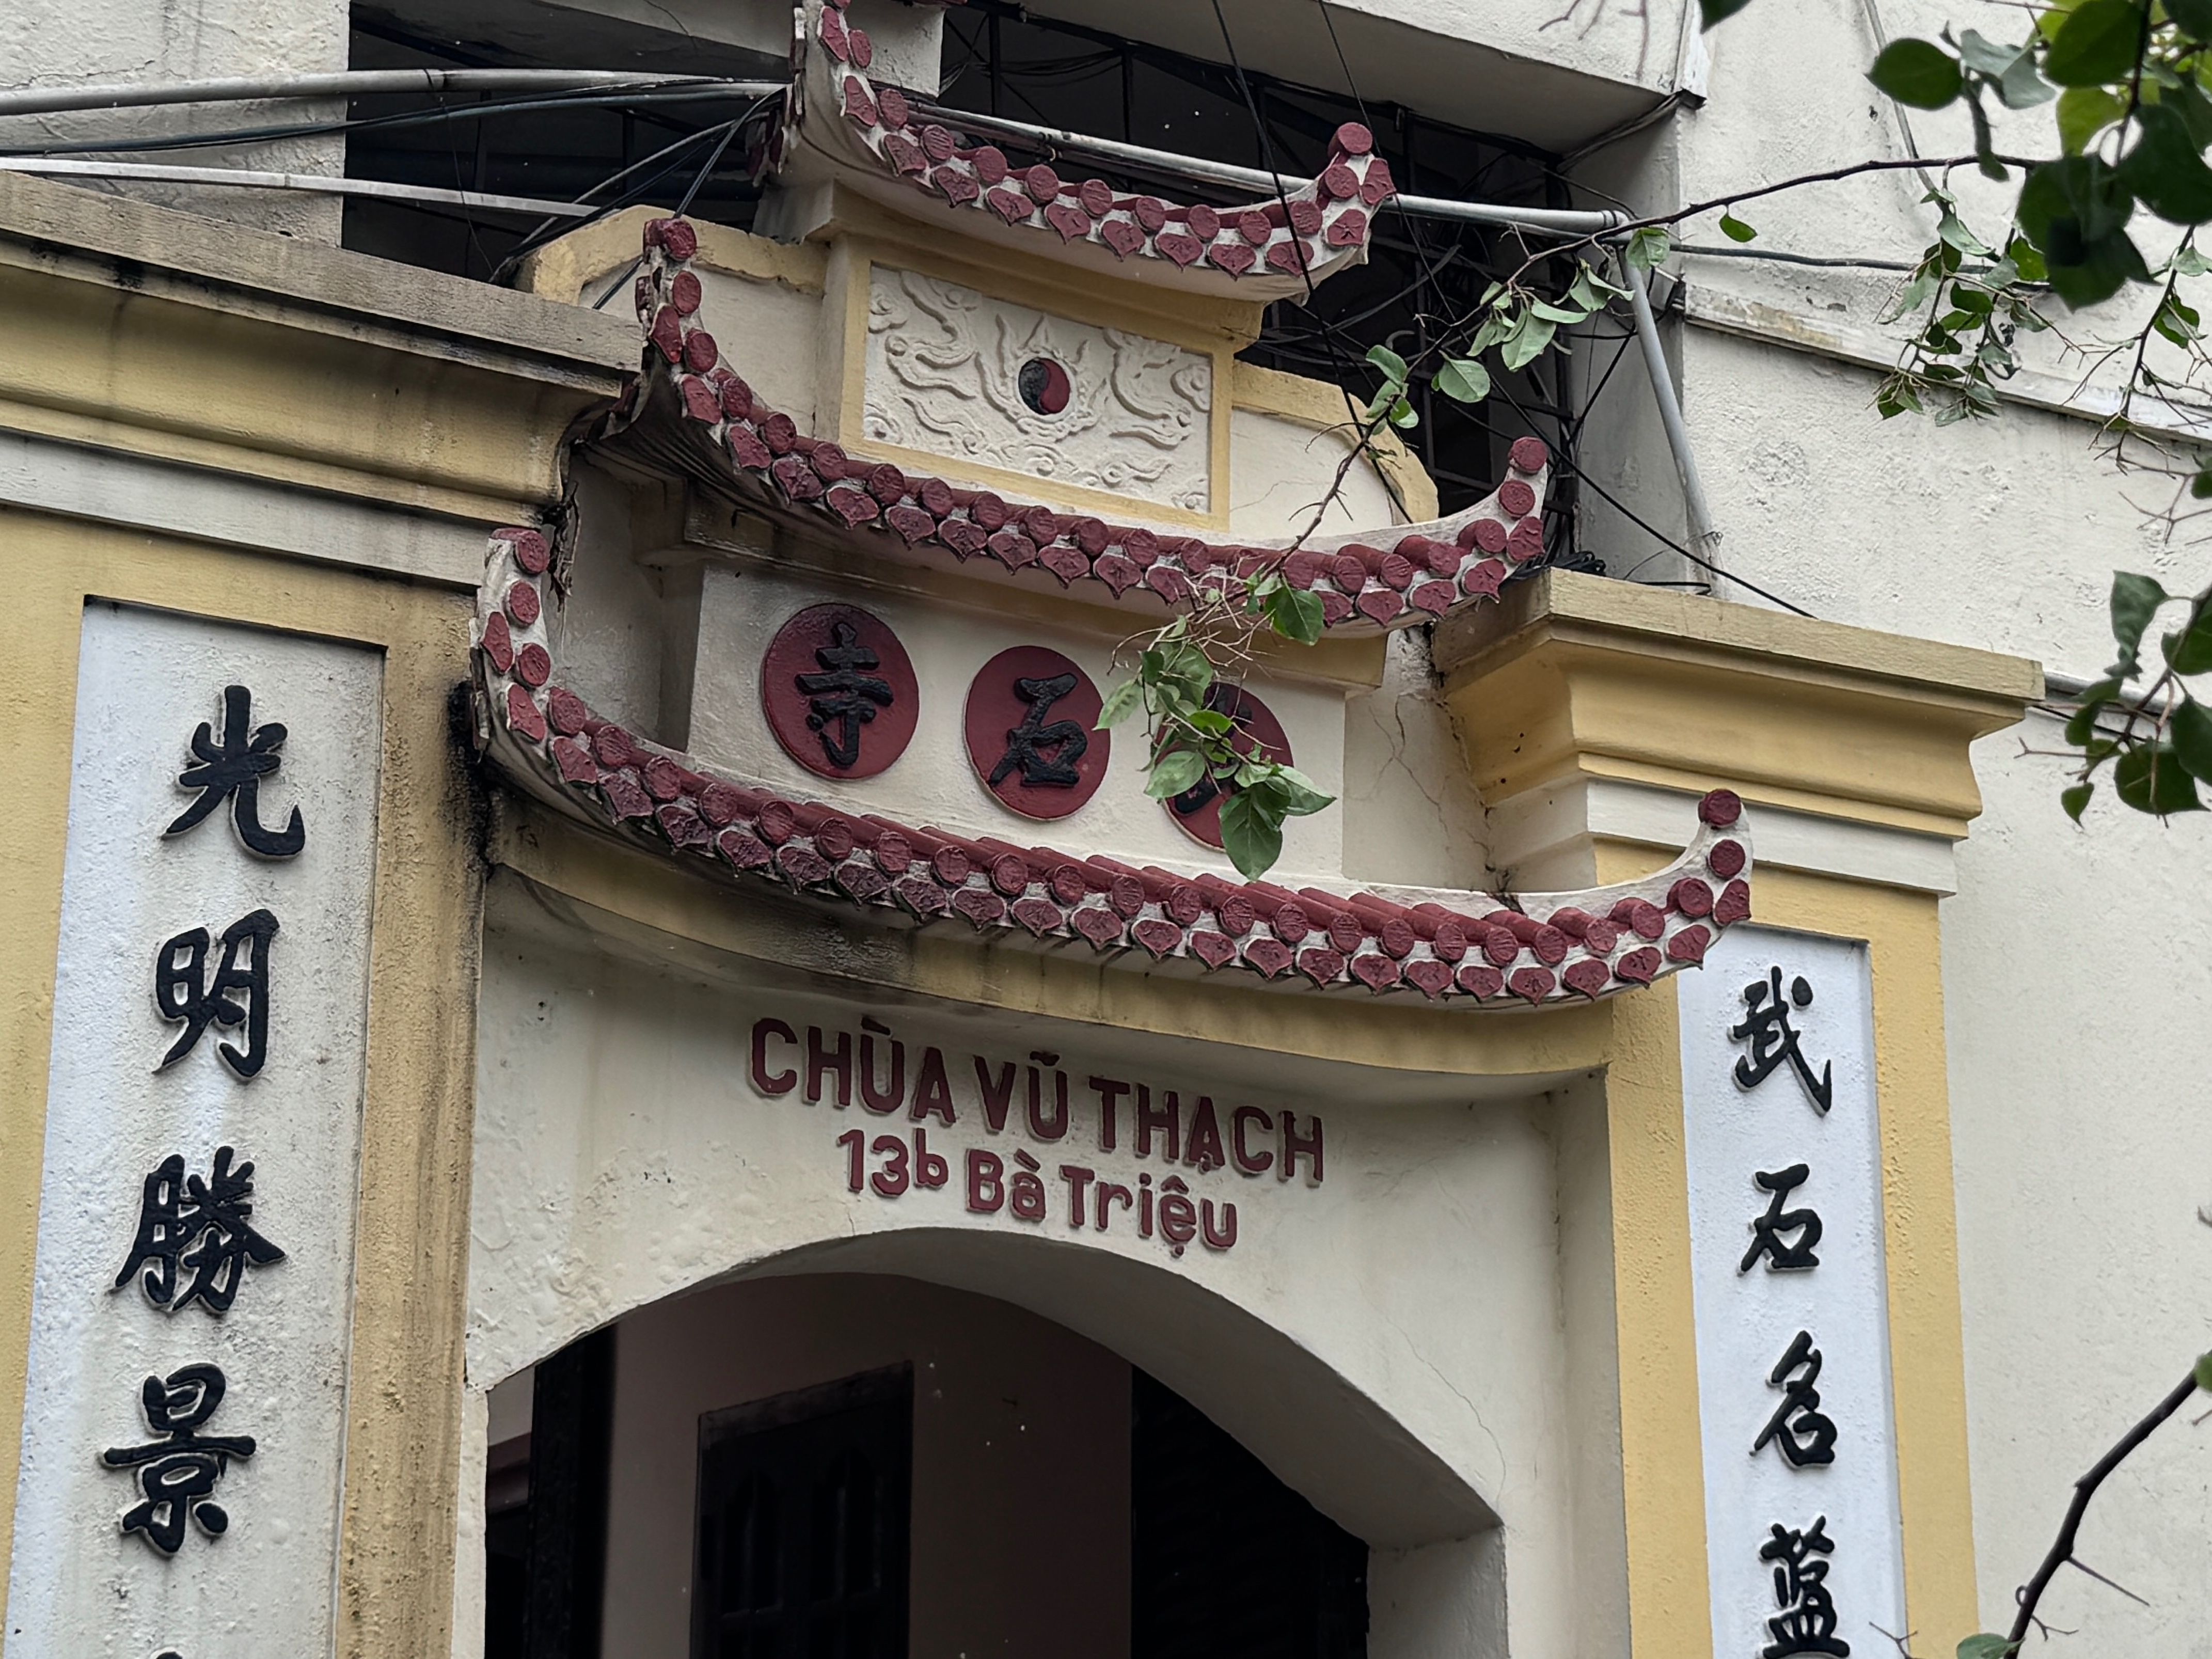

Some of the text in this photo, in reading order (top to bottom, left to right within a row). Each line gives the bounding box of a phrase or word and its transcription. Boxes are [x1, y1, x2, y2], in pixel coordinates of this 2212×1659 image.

[103, 685, 306, 1659] 光明勝景
[750, 1016, 1324, 1182] CHÙA VŨ THẠCH
[838, 1127, 1238, 1257] 13b Bà Triệu
